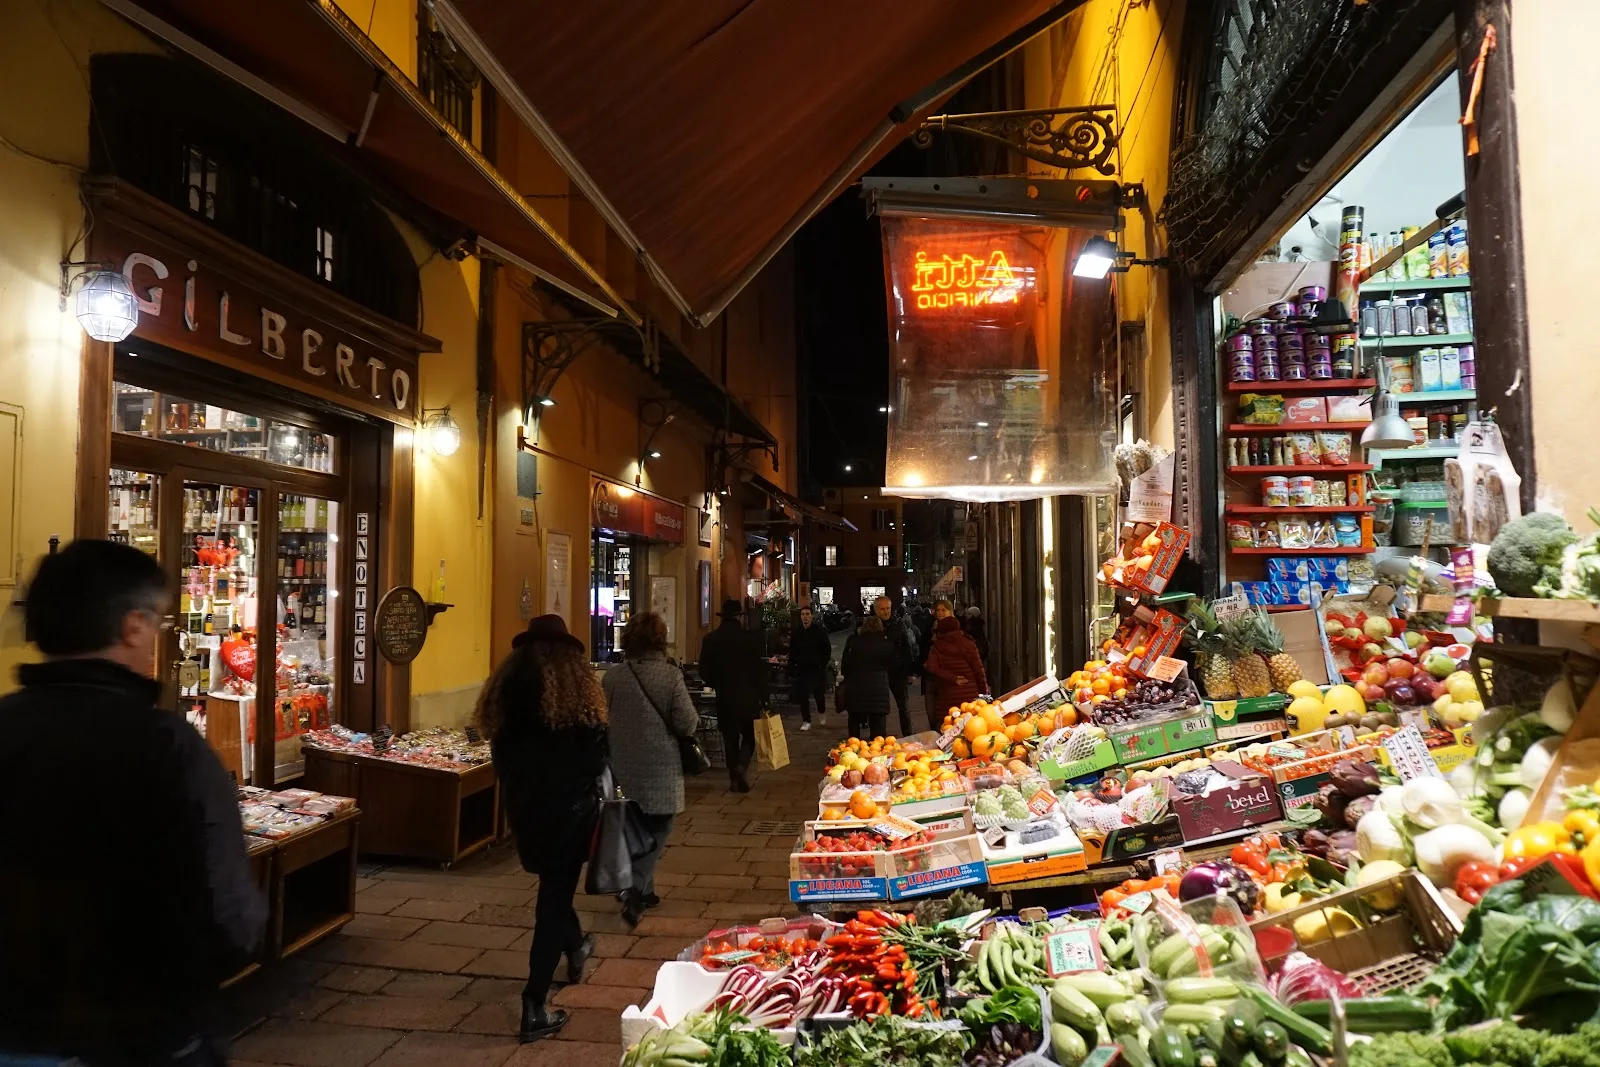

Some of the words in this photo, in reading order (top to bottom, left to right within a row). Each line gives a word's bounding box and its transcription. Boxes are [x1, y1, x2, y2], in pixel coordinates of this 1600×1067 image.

[353, 515, 368, 682] ENOTECA
[1214, 595, 1243, 606] ANANAS
[1226, 603, 1239, 611] AIR
[908, 866, 962, 885] LUCANA
[809, 879, 862, 891] LUCANA
